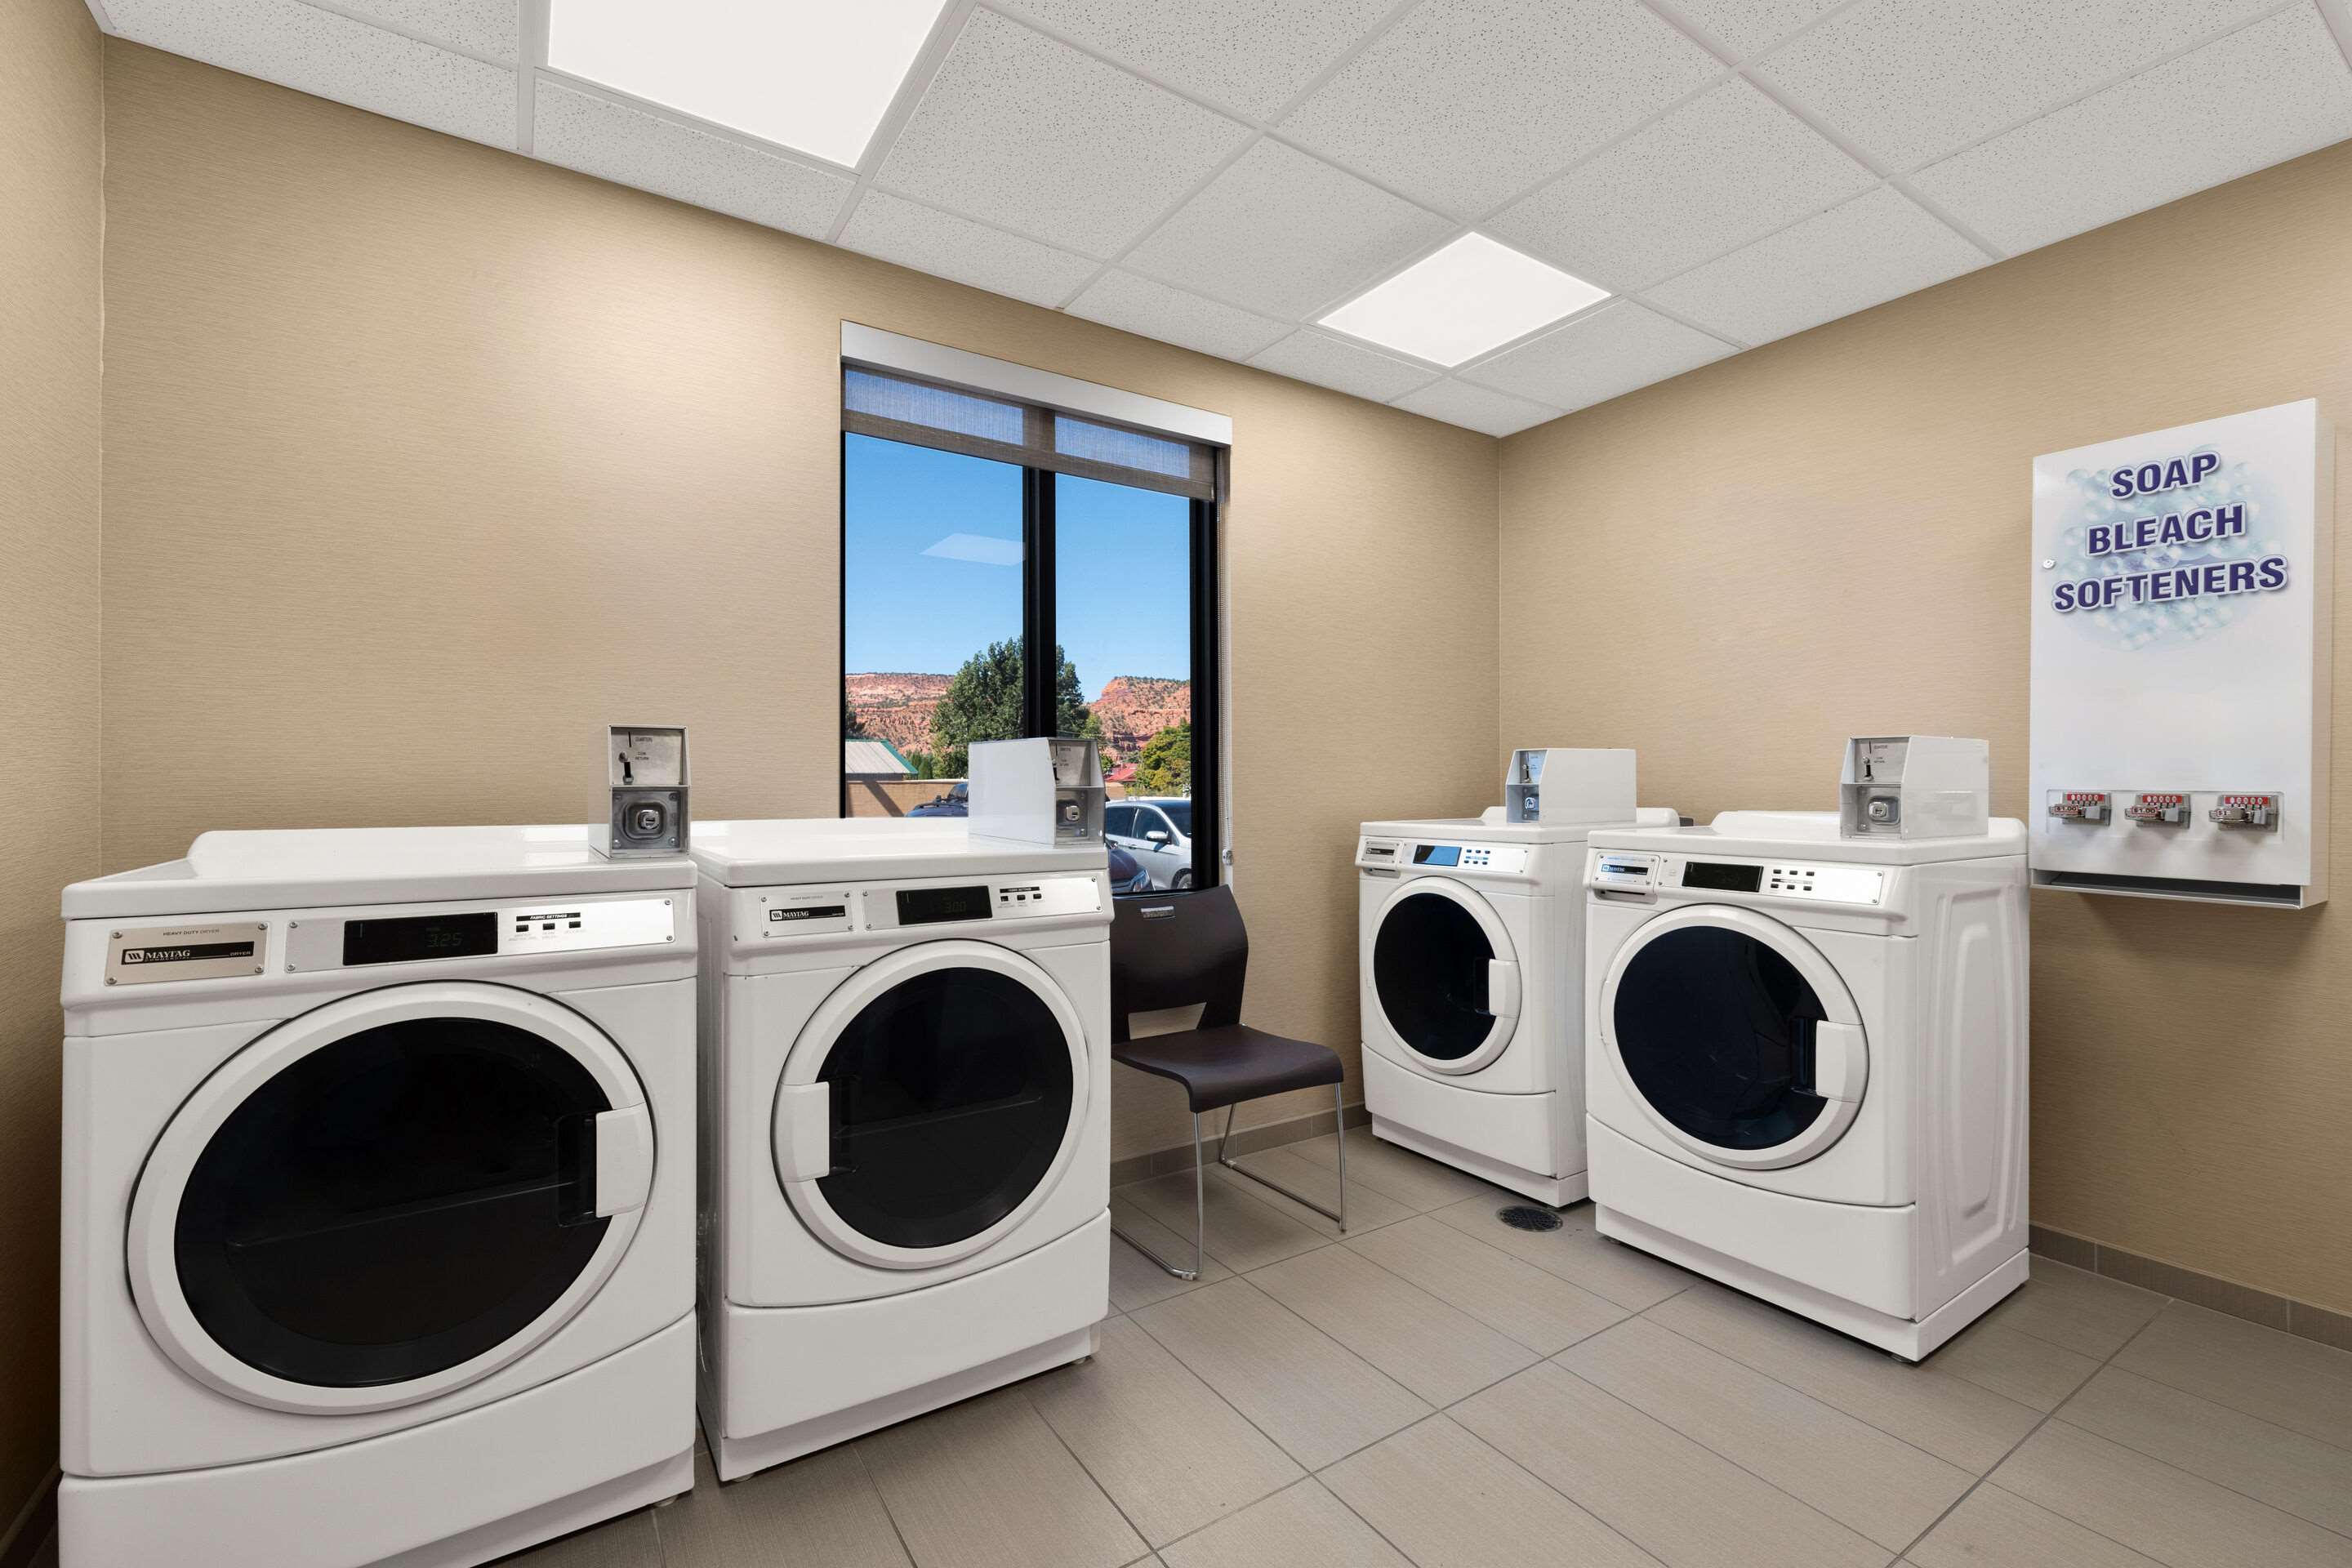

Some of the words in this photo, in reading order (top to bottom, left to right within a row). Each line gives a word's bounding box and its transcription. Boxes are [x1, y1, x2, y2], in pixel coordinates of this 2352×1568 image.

[2111, 452, 2218, 498] SOAP
[2087, 503, 2243, 555] BLEACH
[2052, 556, 2286, 611] SOFTENERS
[145, 950, 190, 960] MAYTAG
